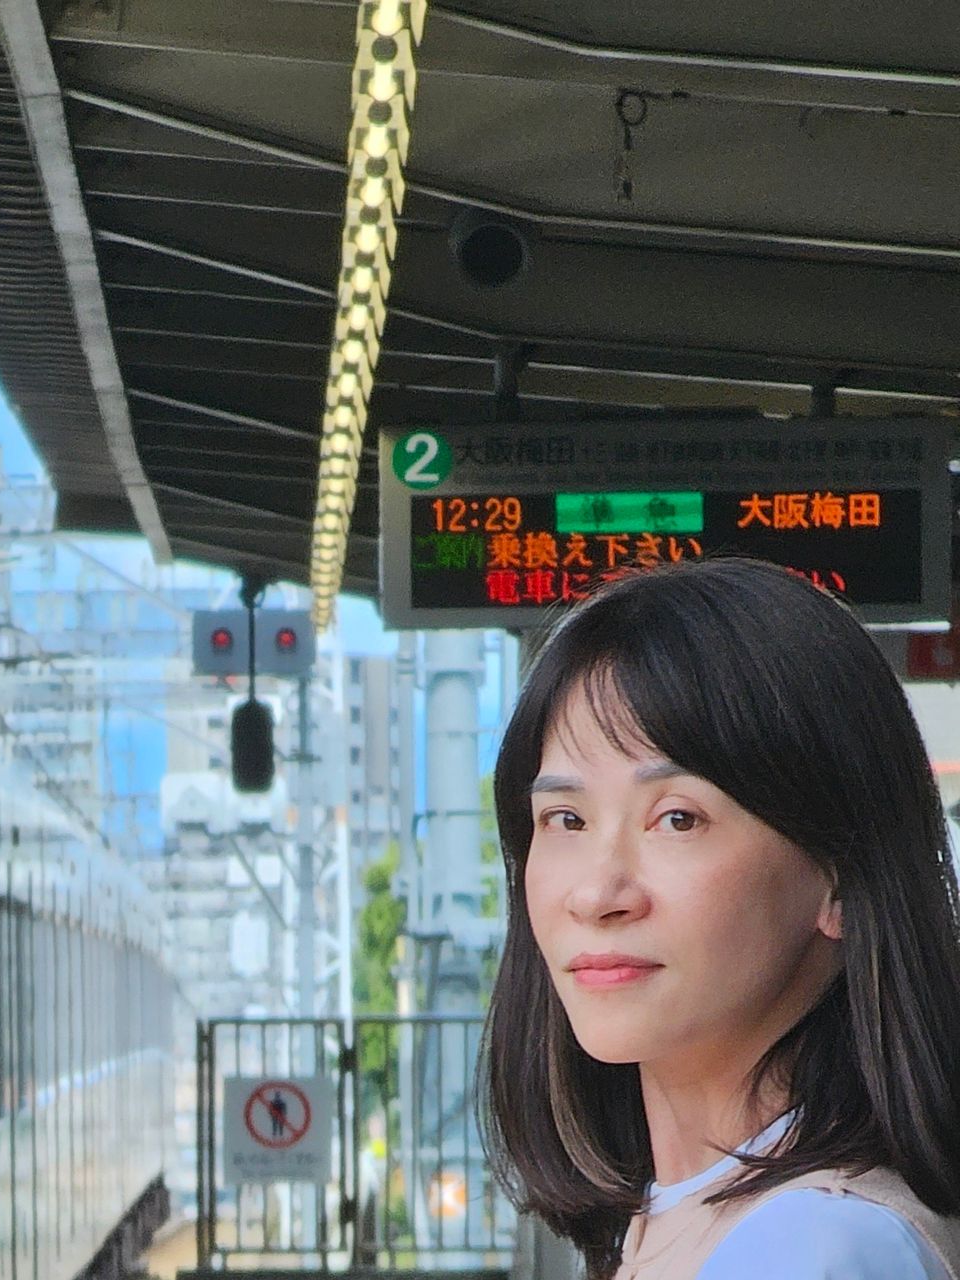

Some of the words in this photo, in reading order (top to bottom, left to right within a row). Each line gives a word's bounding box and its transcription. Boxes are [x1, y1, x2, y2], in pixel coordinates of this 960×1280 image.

[403, 433, 440, 483] 2
[432, 497, 522, 533] 12:29
[737, 493, 882, 529] 大阪梅田
[486, 569, 634, 605] 電車に
